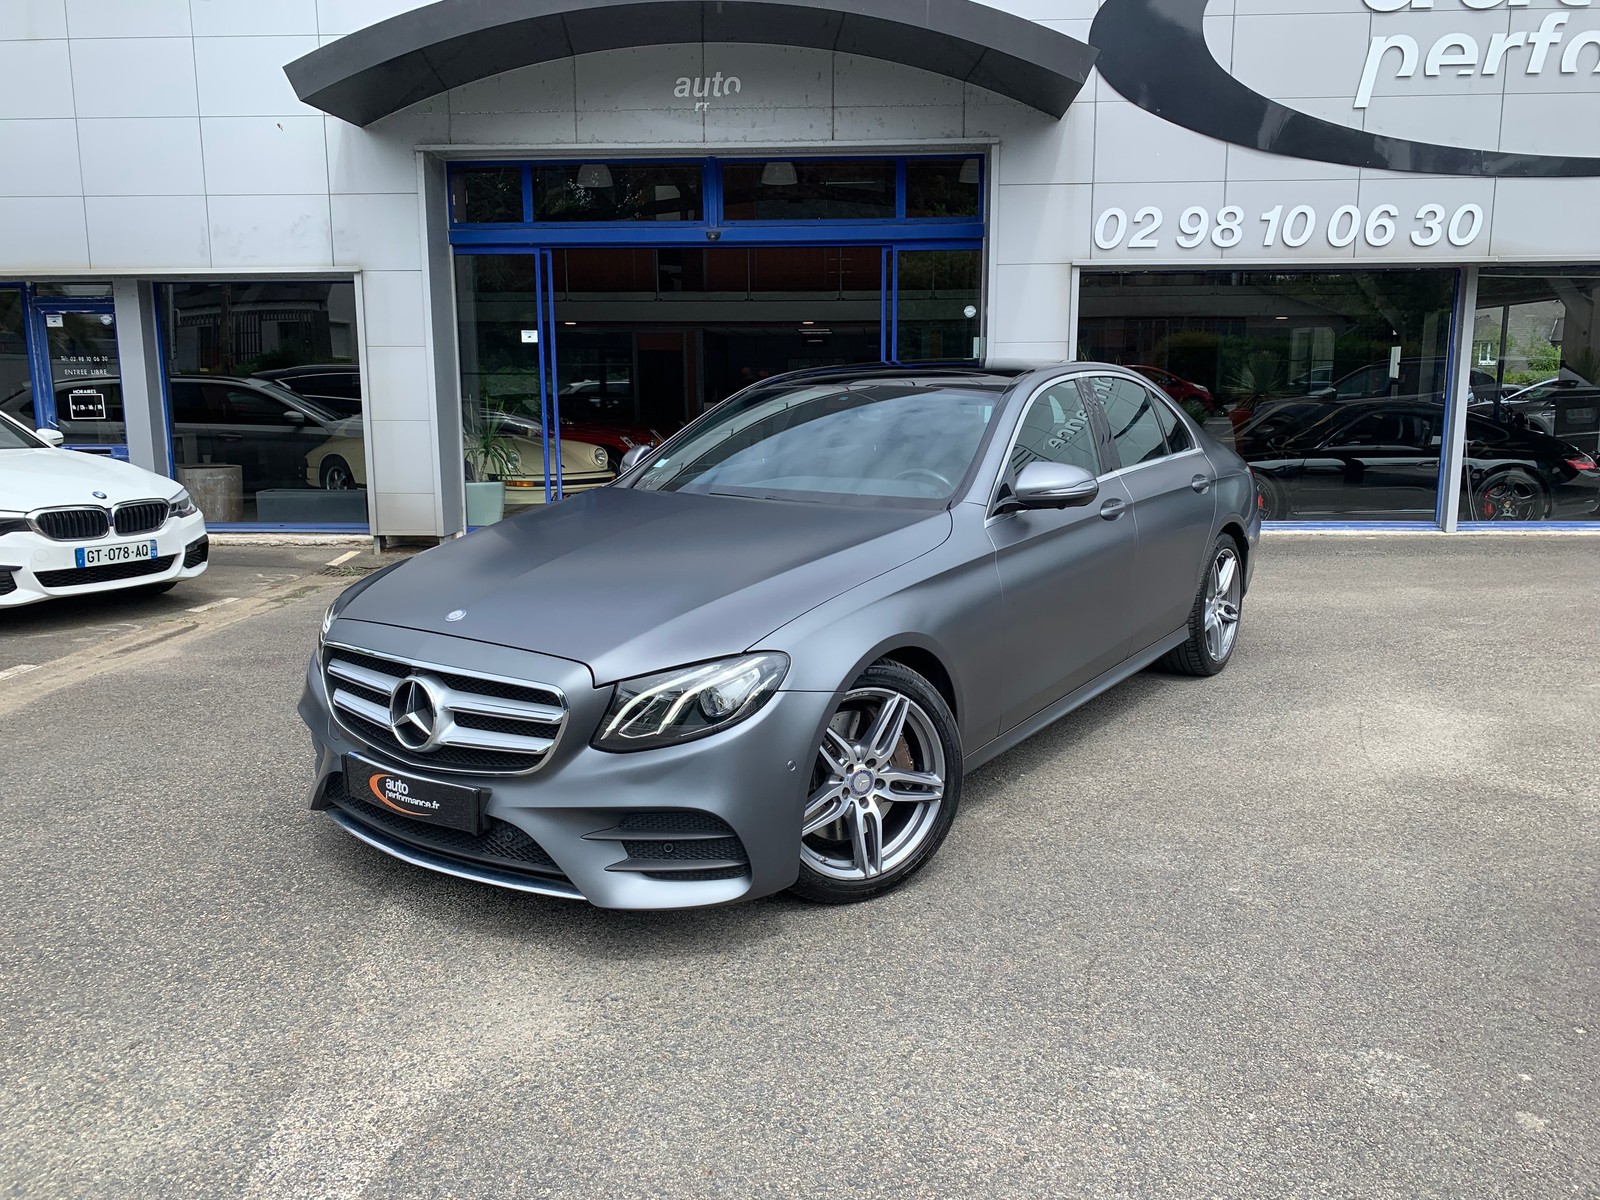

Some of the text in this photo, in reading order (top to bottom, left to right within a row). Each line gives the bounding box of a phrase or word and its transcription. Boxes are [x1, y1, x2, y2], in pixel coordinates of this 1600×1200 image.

[673, 71, 741, 98] auto
[1094, 203, 1484, 250] 02 98 10 06 30
[385, 778, 409, 795] auto
[385, 789, 440, 810] performance.fr
